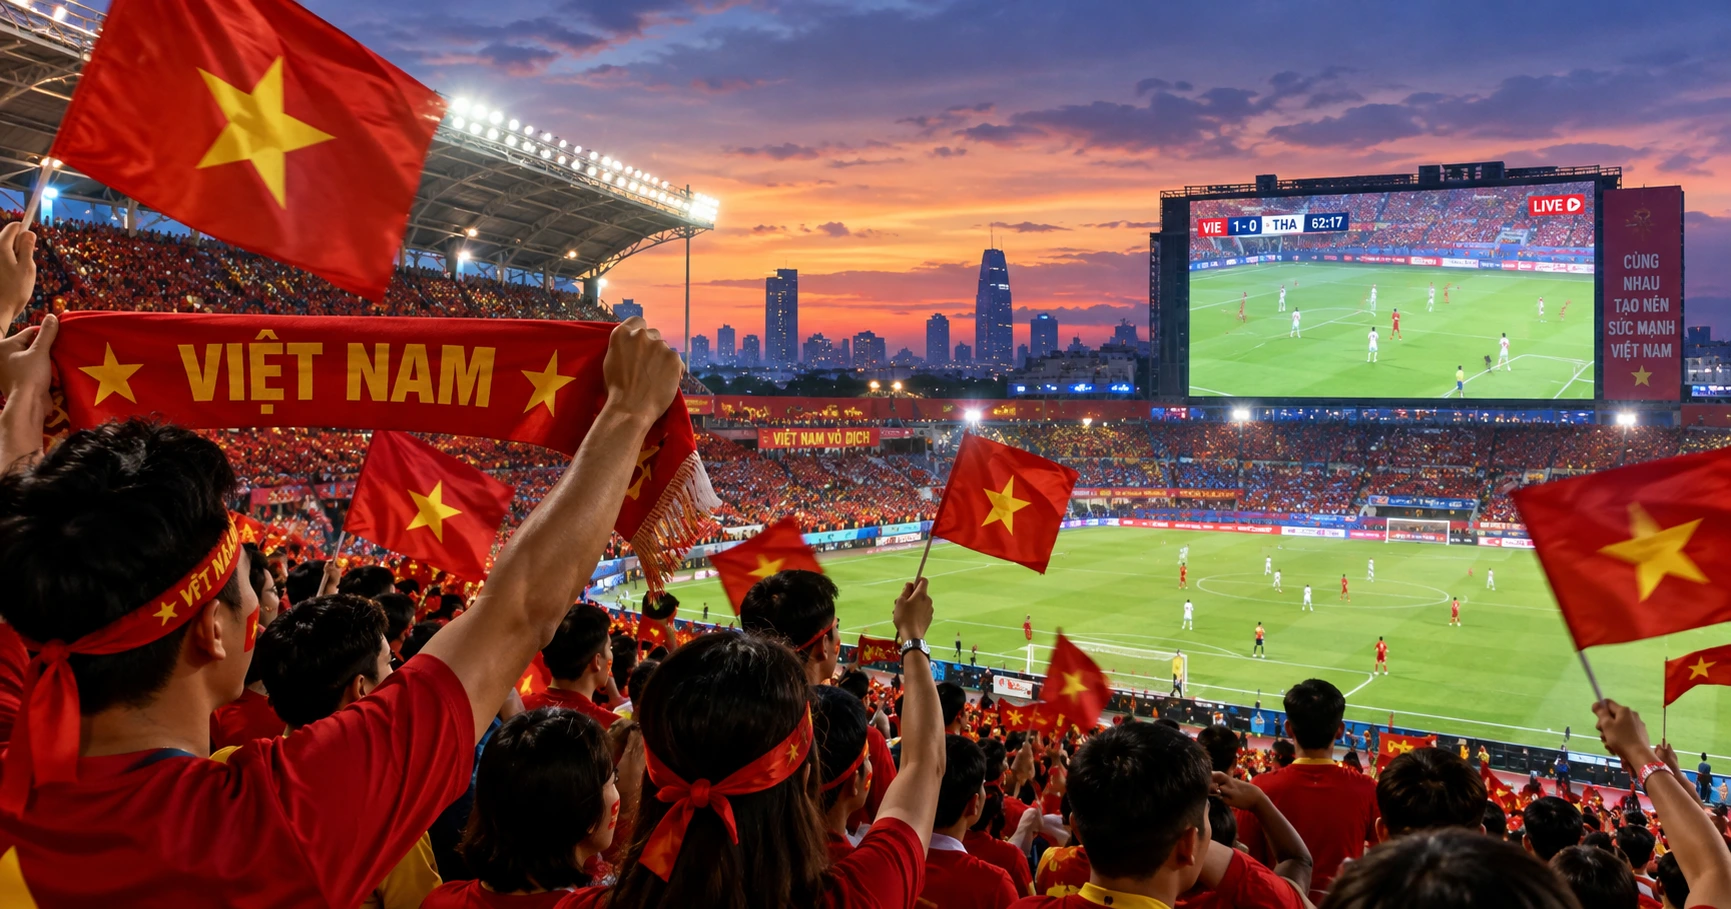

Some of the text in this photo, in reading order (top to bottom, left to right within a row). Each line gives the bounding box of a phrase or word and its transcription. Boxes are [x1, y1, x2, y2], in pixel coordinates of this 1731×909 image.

[1533, 199, 1564, 213] LIVE
[1202, 222, 1222, 234] VIE
[1272, 218, 1298, 231] THA
[1311, 216, 1343, 229] 62:17
[1623, 251, 1659, 270] CÙNG
[1623, 275, 1660, 291] NHAU
[1614, 298, 1640, 316] TẠO
[1608, 317, 1675, 339] SỨC MẠNH
[1610, 340, 1672, 362] VIỆT NAM
[177, 329, 496, 415] VIỆT NAM
[801, 431, 825, 445] NAM
